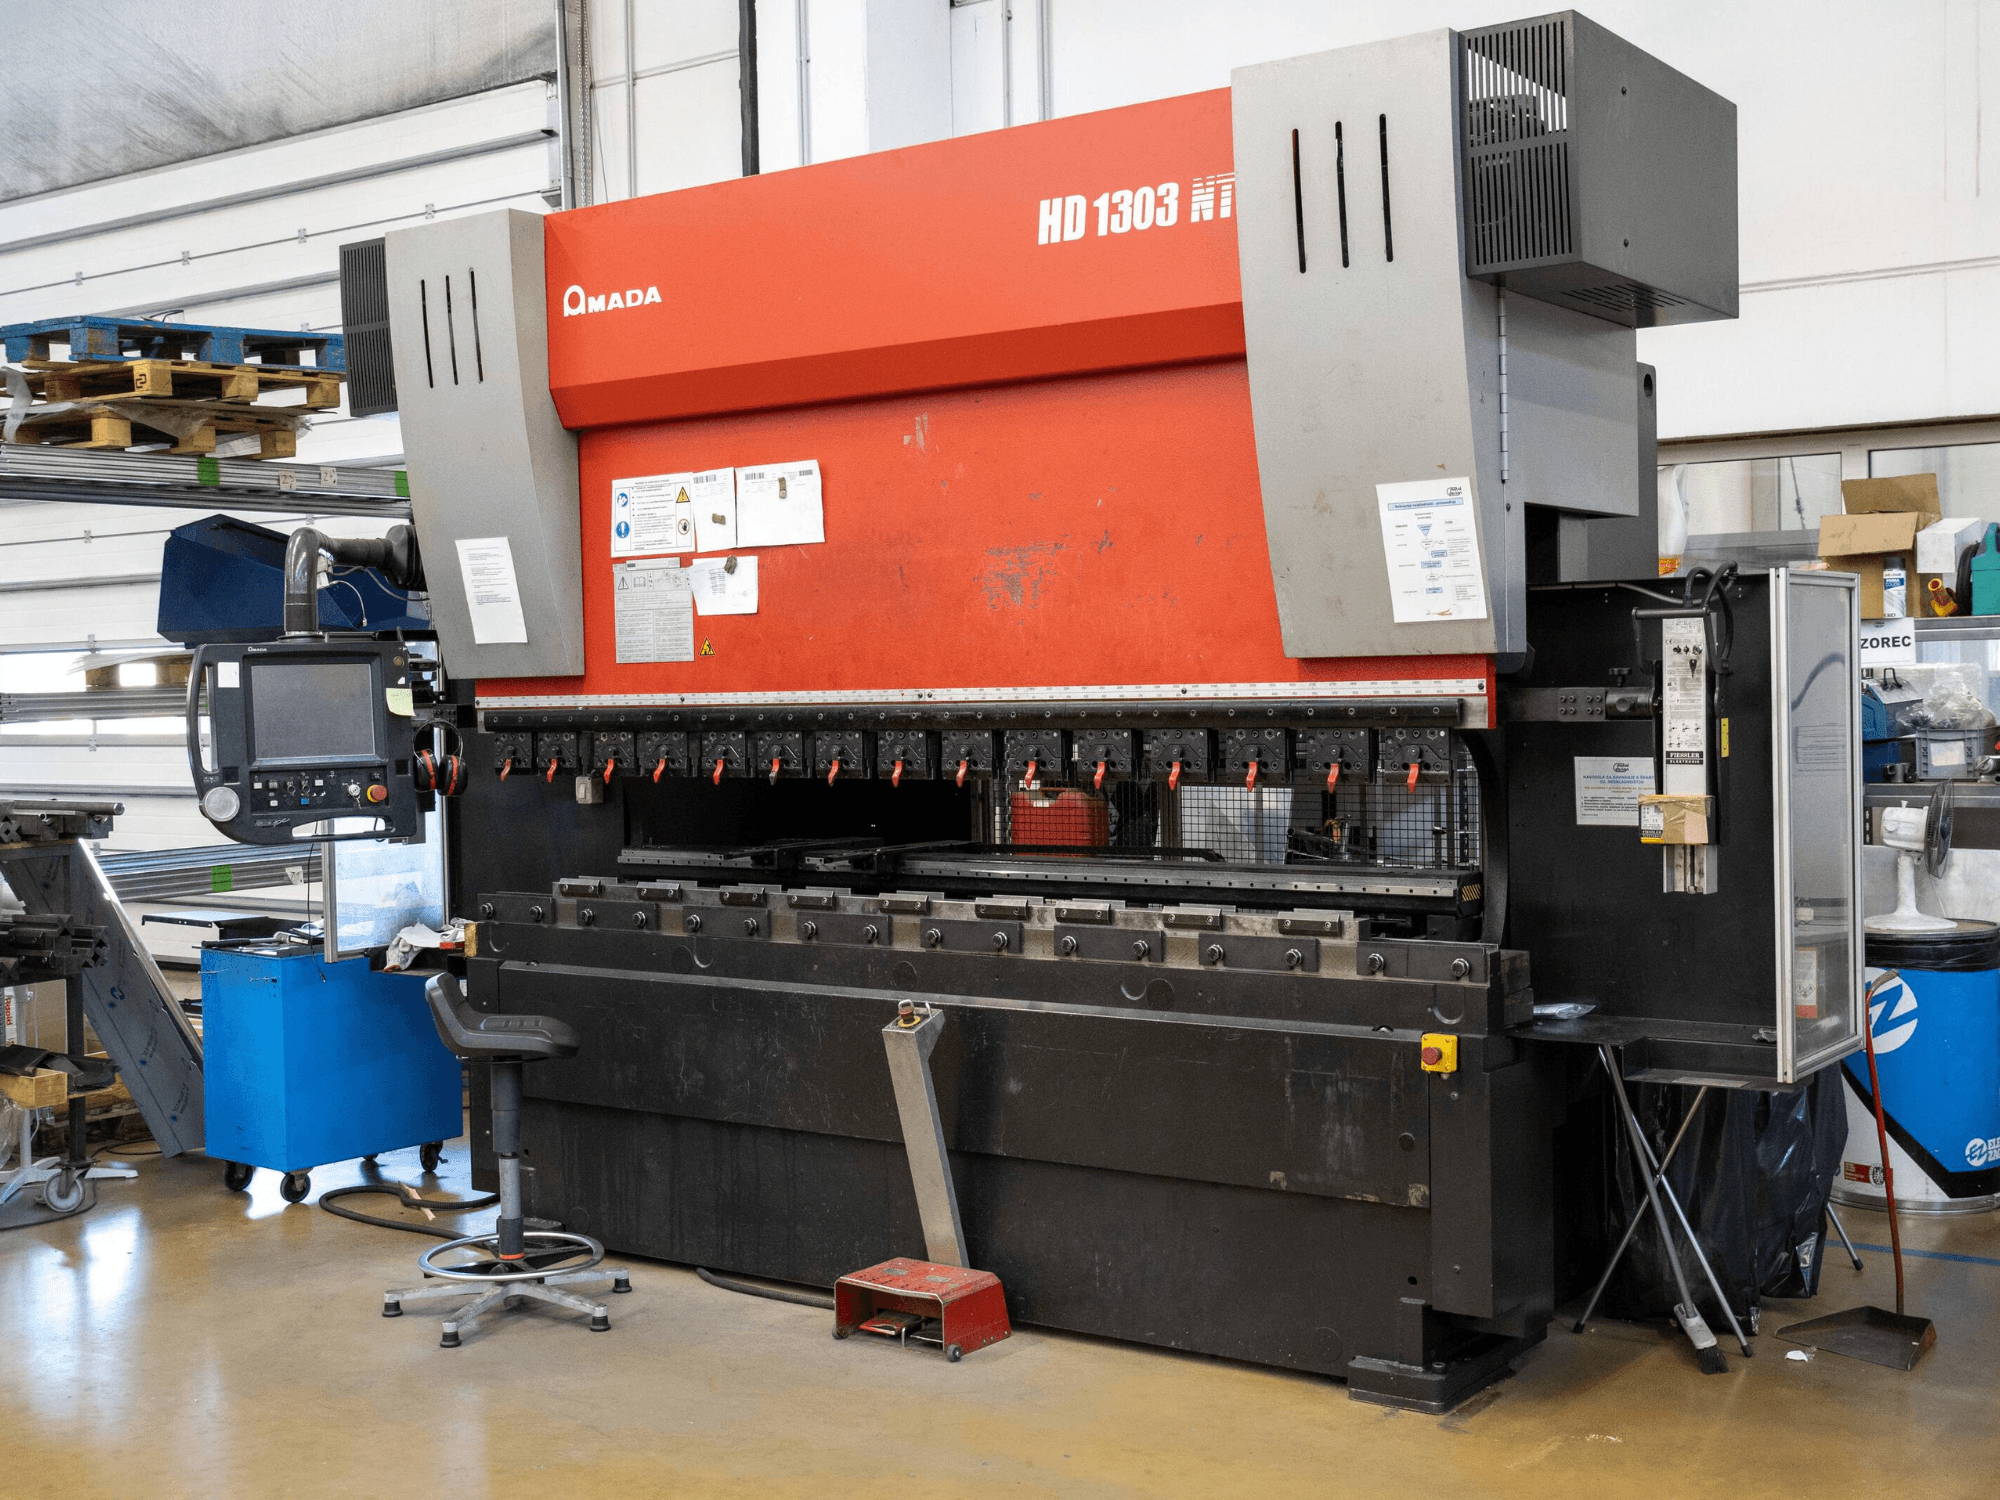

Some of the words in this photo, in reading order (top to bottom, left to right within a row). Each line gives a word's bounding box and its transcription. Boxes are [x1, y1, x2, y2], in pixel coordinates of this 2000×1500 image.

[1038, 194, 1087, 245] HD
[1093, 182, 1179, 236] 1303
[1190, 172, 1236, 223] NT
[563, 284, 662, 317] AMADA
